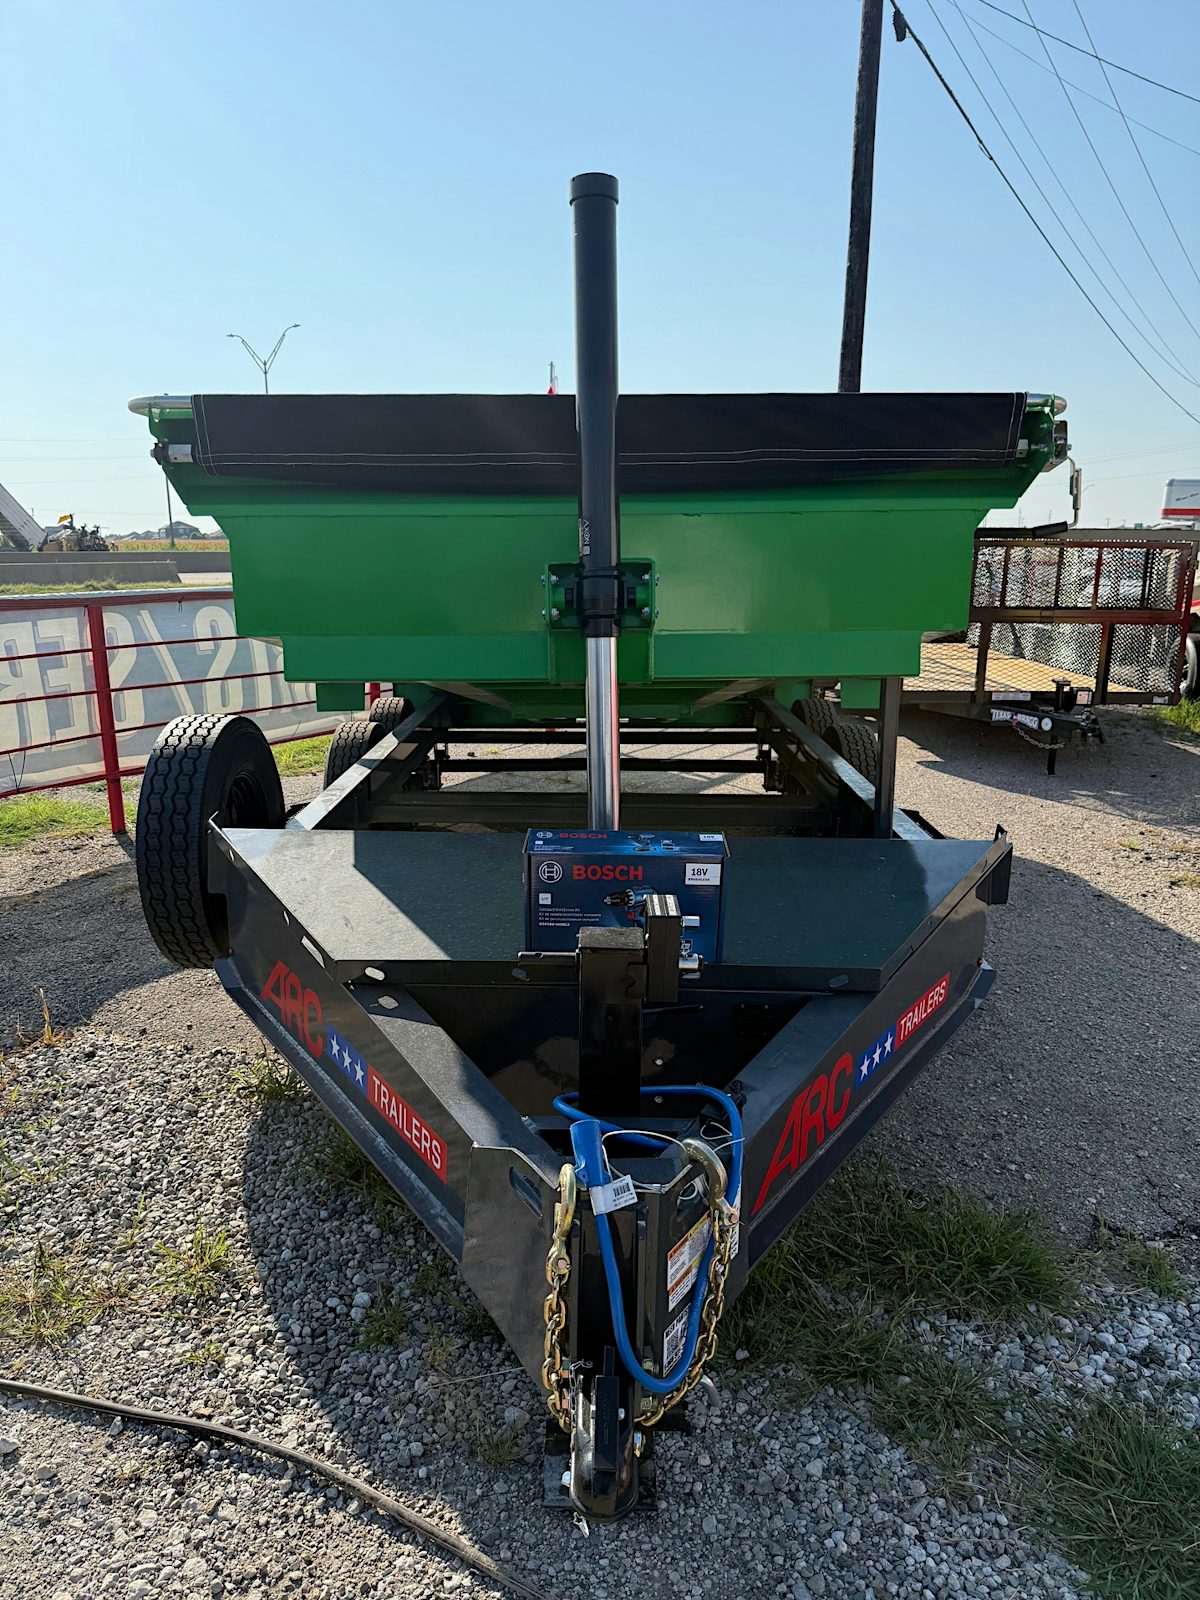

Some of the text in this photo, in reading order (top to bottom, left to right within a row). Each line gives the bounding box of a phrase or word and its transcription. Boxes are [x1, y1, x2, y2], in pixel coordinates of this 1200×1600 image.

[572, 864, 643, 881] BOSCH
[691, 868, 709, 876] 18V
[260, 960, 441, 1170] ARC TRAILERS
[751, 980, 947, 1217] ARC TRAILERS
